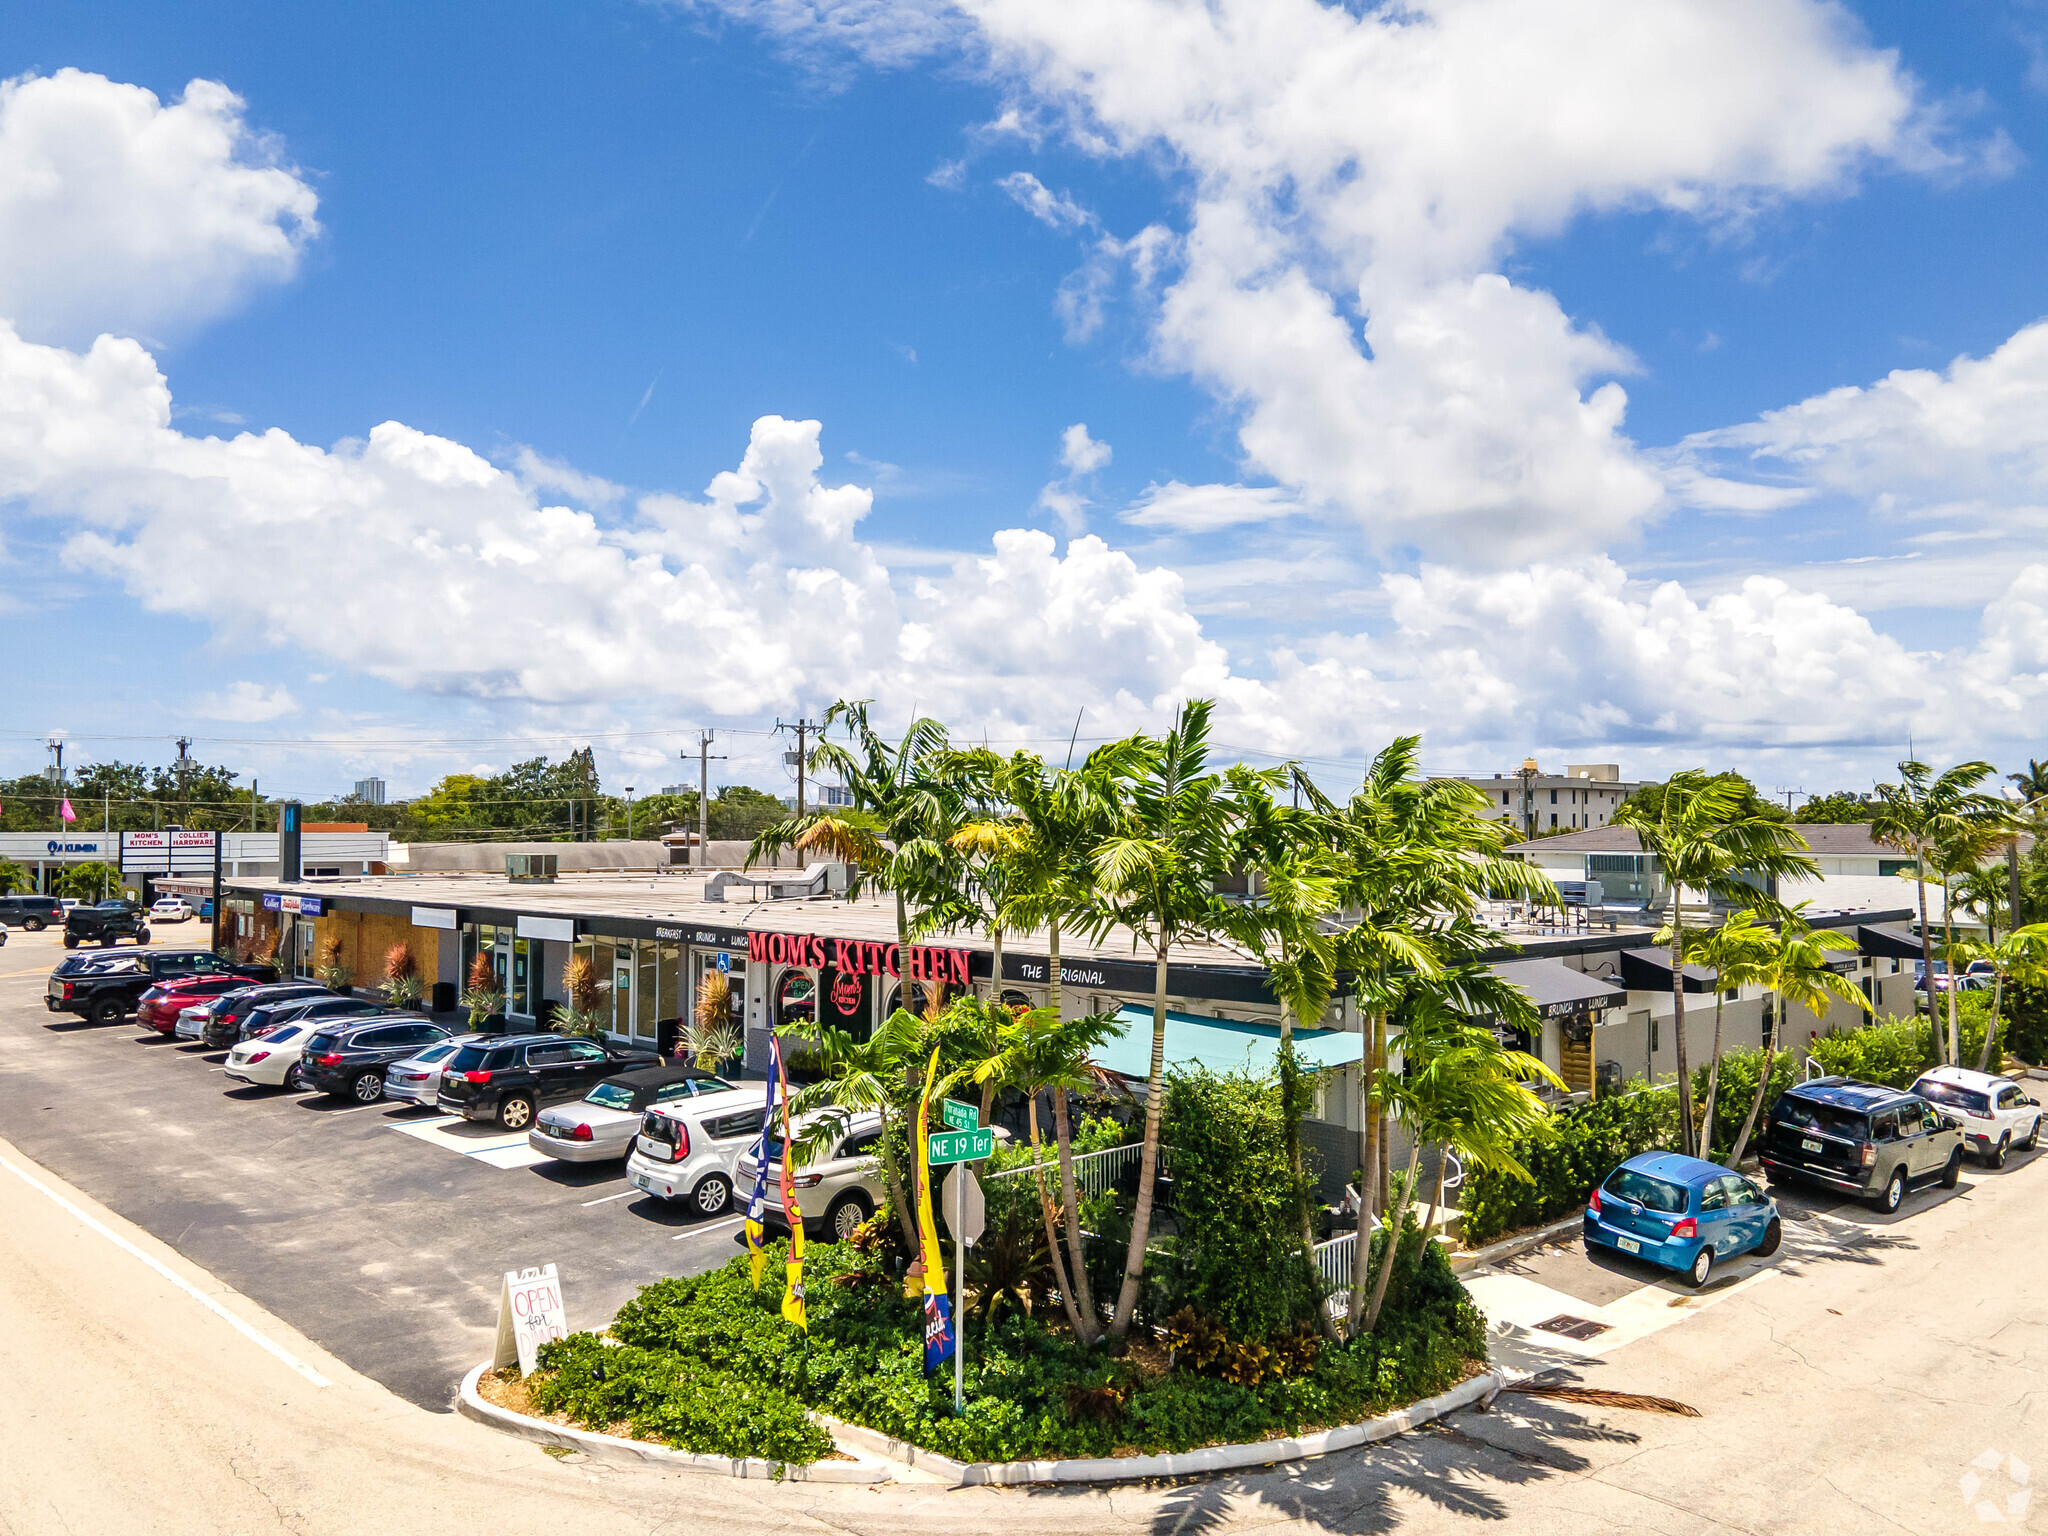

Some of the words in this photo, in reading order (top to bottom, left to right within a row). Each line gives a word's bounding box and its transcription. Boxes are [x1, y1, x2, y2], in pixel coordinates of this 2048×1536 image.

[656, 927, 682, 940] BREAKFAST
[696, 931, 717, 943] BRUNCH
[731, 935, 749, 947] LUNCH
[747, 931, 826, 970] MOM'S
[833, 938, 971, 986] KITCHEN
[1021, 964, 1043, 979] THE
[1059, 967, 1106, 985] RIGINAL
[1548, 1001, 1574, 1017] BRUNCH
[1588, 996, 1608, 1010] LUNCH
[949, 1115, 955, 1123] NE
[968, 1108, 977, 1121] Rd
[932, 1139, 949, 1158] NE
[954, 1137, 968, 1155] 19
[972, 1135, 989, 1152] Ter
[514, 1285, 560, 1317] OPEN
[524, 1313, 553, 1331] for
